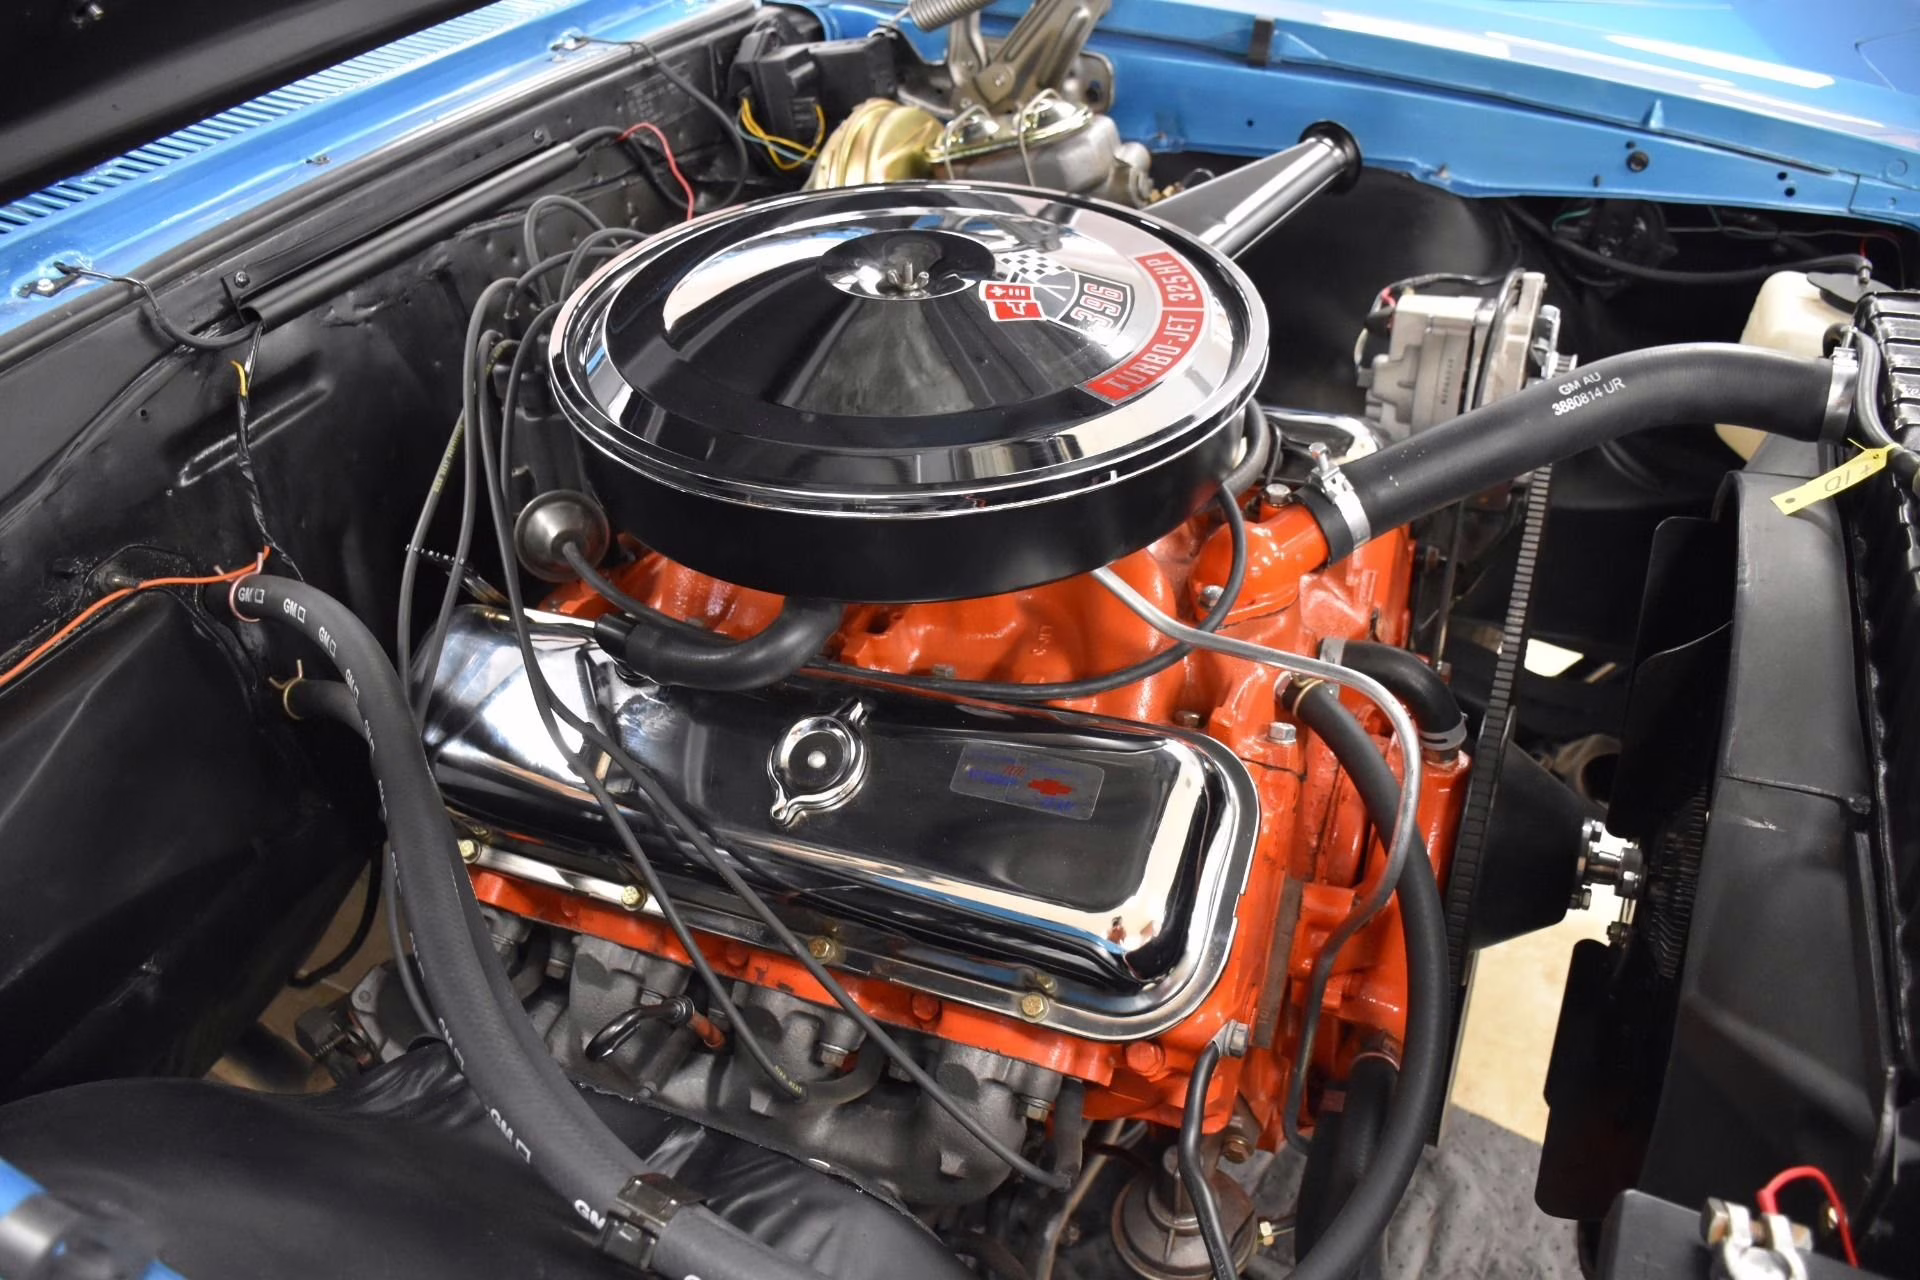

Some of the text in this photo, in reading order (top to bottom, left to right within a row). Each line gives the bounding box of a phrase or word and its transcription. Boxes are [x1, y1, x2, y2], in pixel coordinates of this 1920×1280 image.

[1070, 282, 1124, 329] 396
[1102, 314, 1197, 391] TURBO-JET
[1558, 372, 1602, 395] GM AU
[1603, 377, 1626, 394] UR
[237, 587, 253, 603] GM
[283, 598, 299, 618] GM
[318, 626, 331, 650] GM
